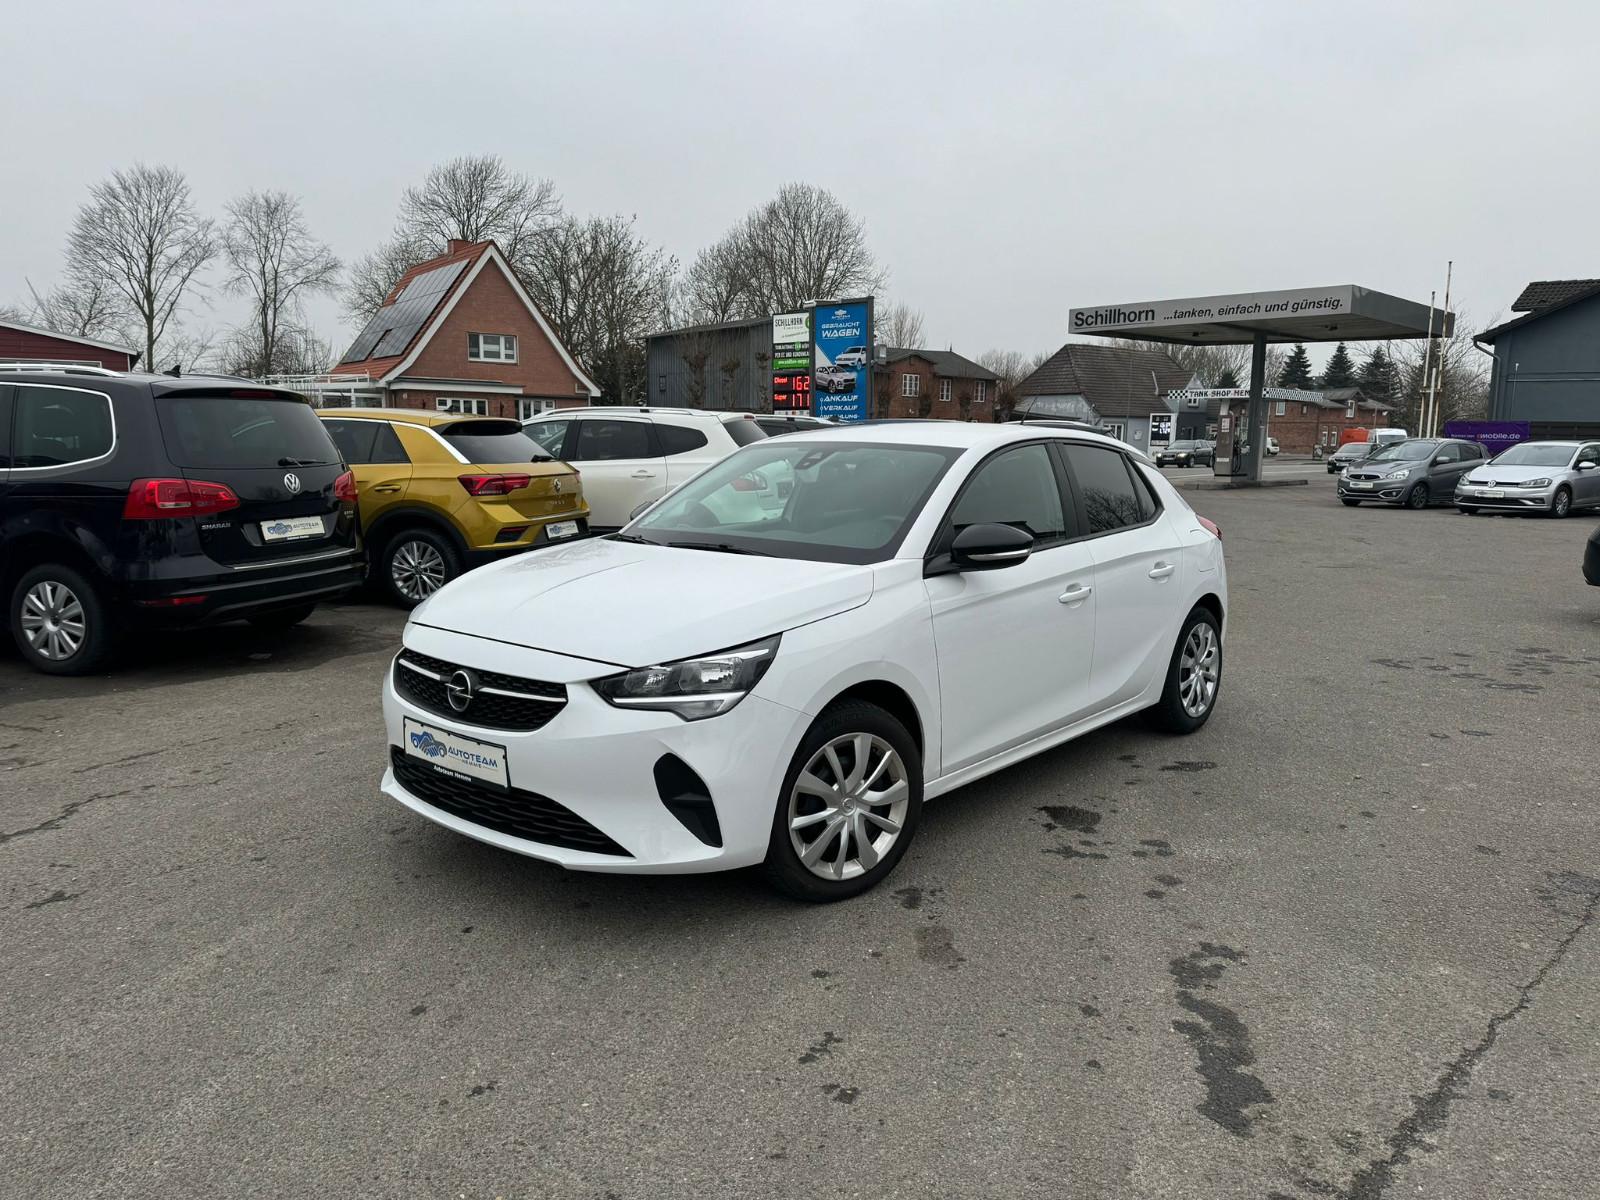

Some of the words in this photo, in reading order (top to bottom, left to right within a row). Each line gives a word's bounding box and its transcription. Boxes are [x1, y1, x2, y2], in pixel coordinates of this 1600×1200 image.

[1074, 308, 1155, 328] Schillhorn
[1217, 303, 1261, 316] einfach
[1265, 300, 1288, 313] und
[1291, 297, 1343, 313] günstig.
[822, 328, 860, 337] WAGEN
[792, 375, 810, 391] 162
[823, 394, 858, 402] ANKAUF
[1189, 390, 1209, 398] TANK
[1211, 389, 1232, 397] SHOP
[792, 393, 810, 407] 171
[201, 522, 231, 530] SHARAN
[448, 746, 498, 768] AUTOTEAM
